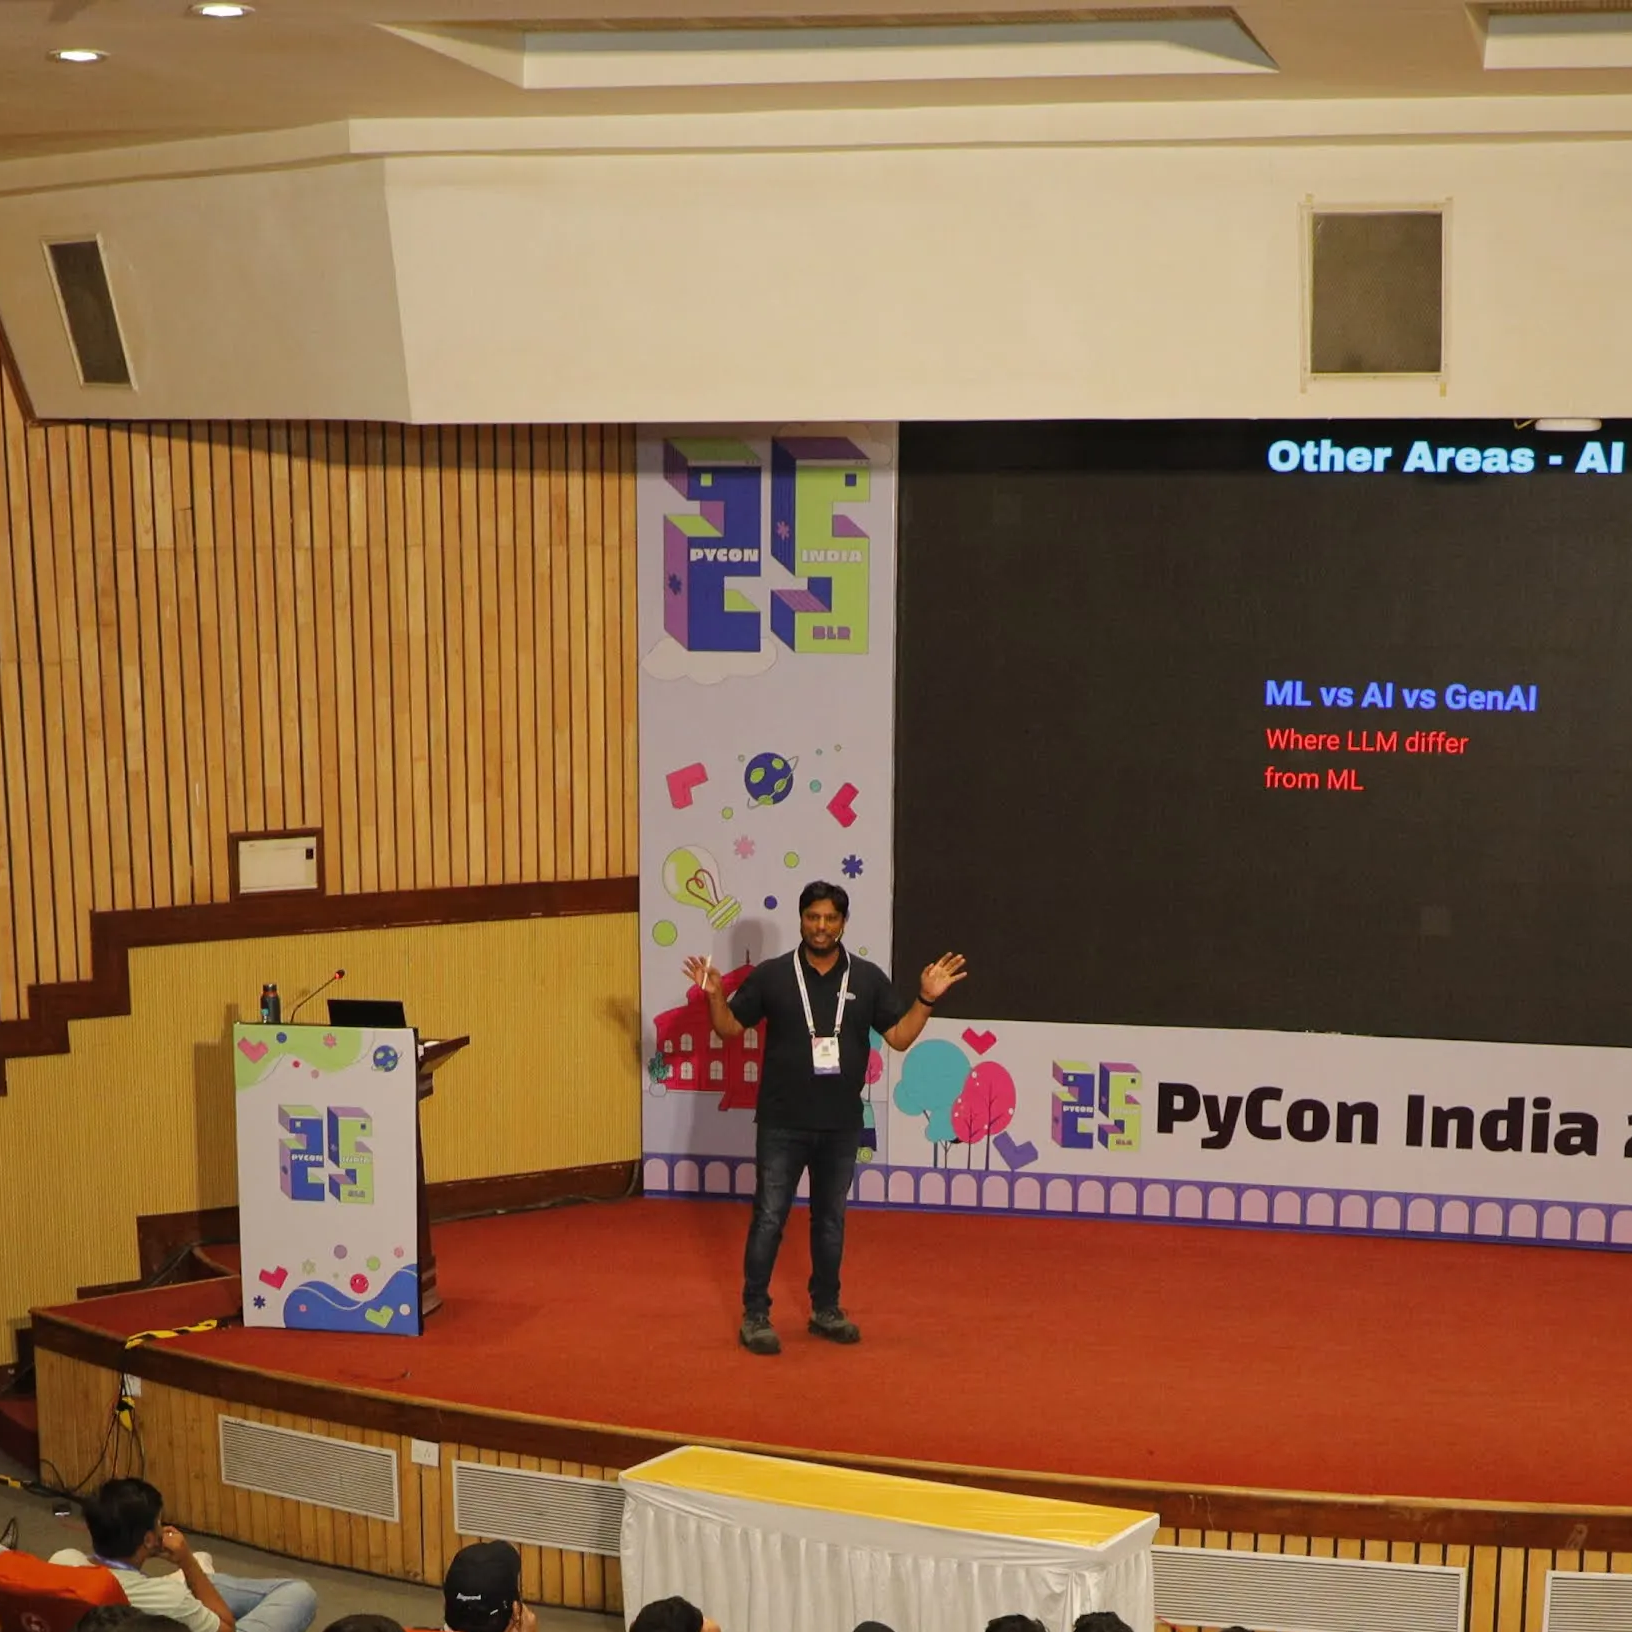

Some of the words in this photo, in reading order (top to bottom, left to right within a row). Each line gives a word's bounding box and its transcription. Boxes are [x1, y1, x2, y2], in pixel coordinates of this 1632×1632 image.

[1267, 438, 1393, 474] Other
[1402, 439, 1536, 474] Areas
[1573, 440, 1626, 475] AI
[688, 547, 760, 563] PYCON
[800, 549, 864, 563] INDIA
[812, 624, 852, 641] BLR
[1263, 678, 1313, 708] ML
[1318, 685, 1356, 709] vs
[1359, 680, 1395, 710] AI
[1401, 687, 1438, 711] vs
[1443, 682, 1539, 713] GenAI
[1265, 726, 1342, 752] Where
[1346, 729, 1399, 753] LLM
[1403, 729, 1471, 755] differ
[1263, 764, 1321, 790] from
[1325, 767, 1365, 792] ML
[1156, 1081, 1380, 1151] PyCon
[1404, 1093, 1600, 1157] India
[291, 1153, 324, 1162] PYCON
